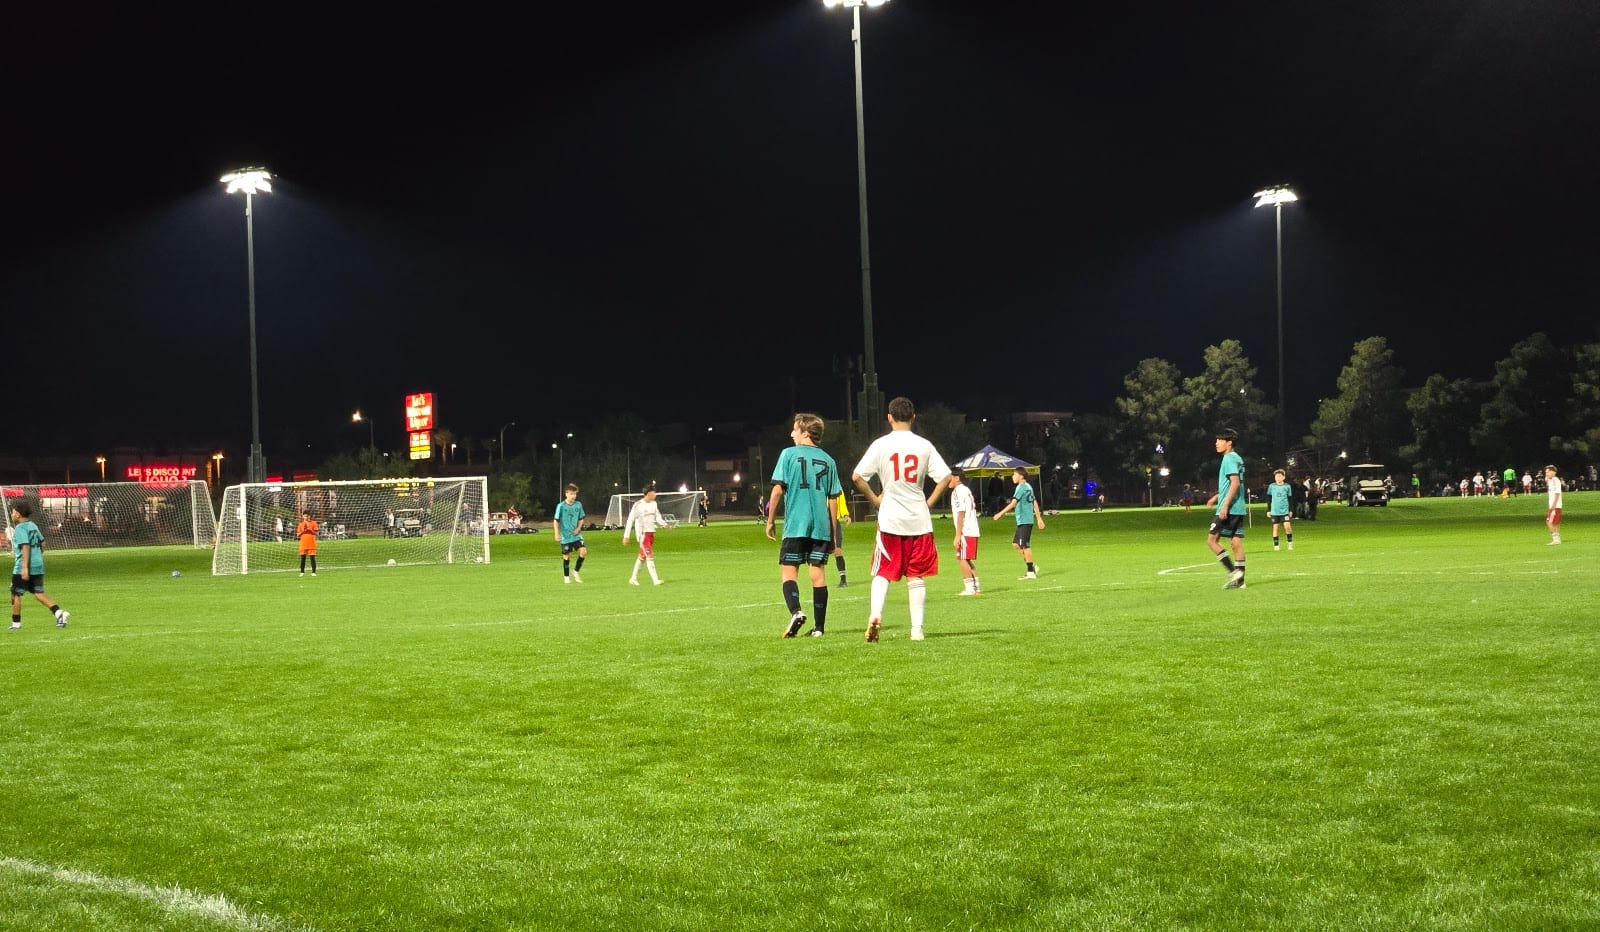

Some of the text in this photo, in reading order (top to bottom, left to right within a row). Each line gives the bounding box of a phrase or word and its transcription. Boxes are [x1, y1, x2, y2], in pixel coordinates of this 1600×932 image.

[153, 468, 196, 476] DISCONT
[798, 457, 829, 490] 17
[890, 453, 918, 483] 12
